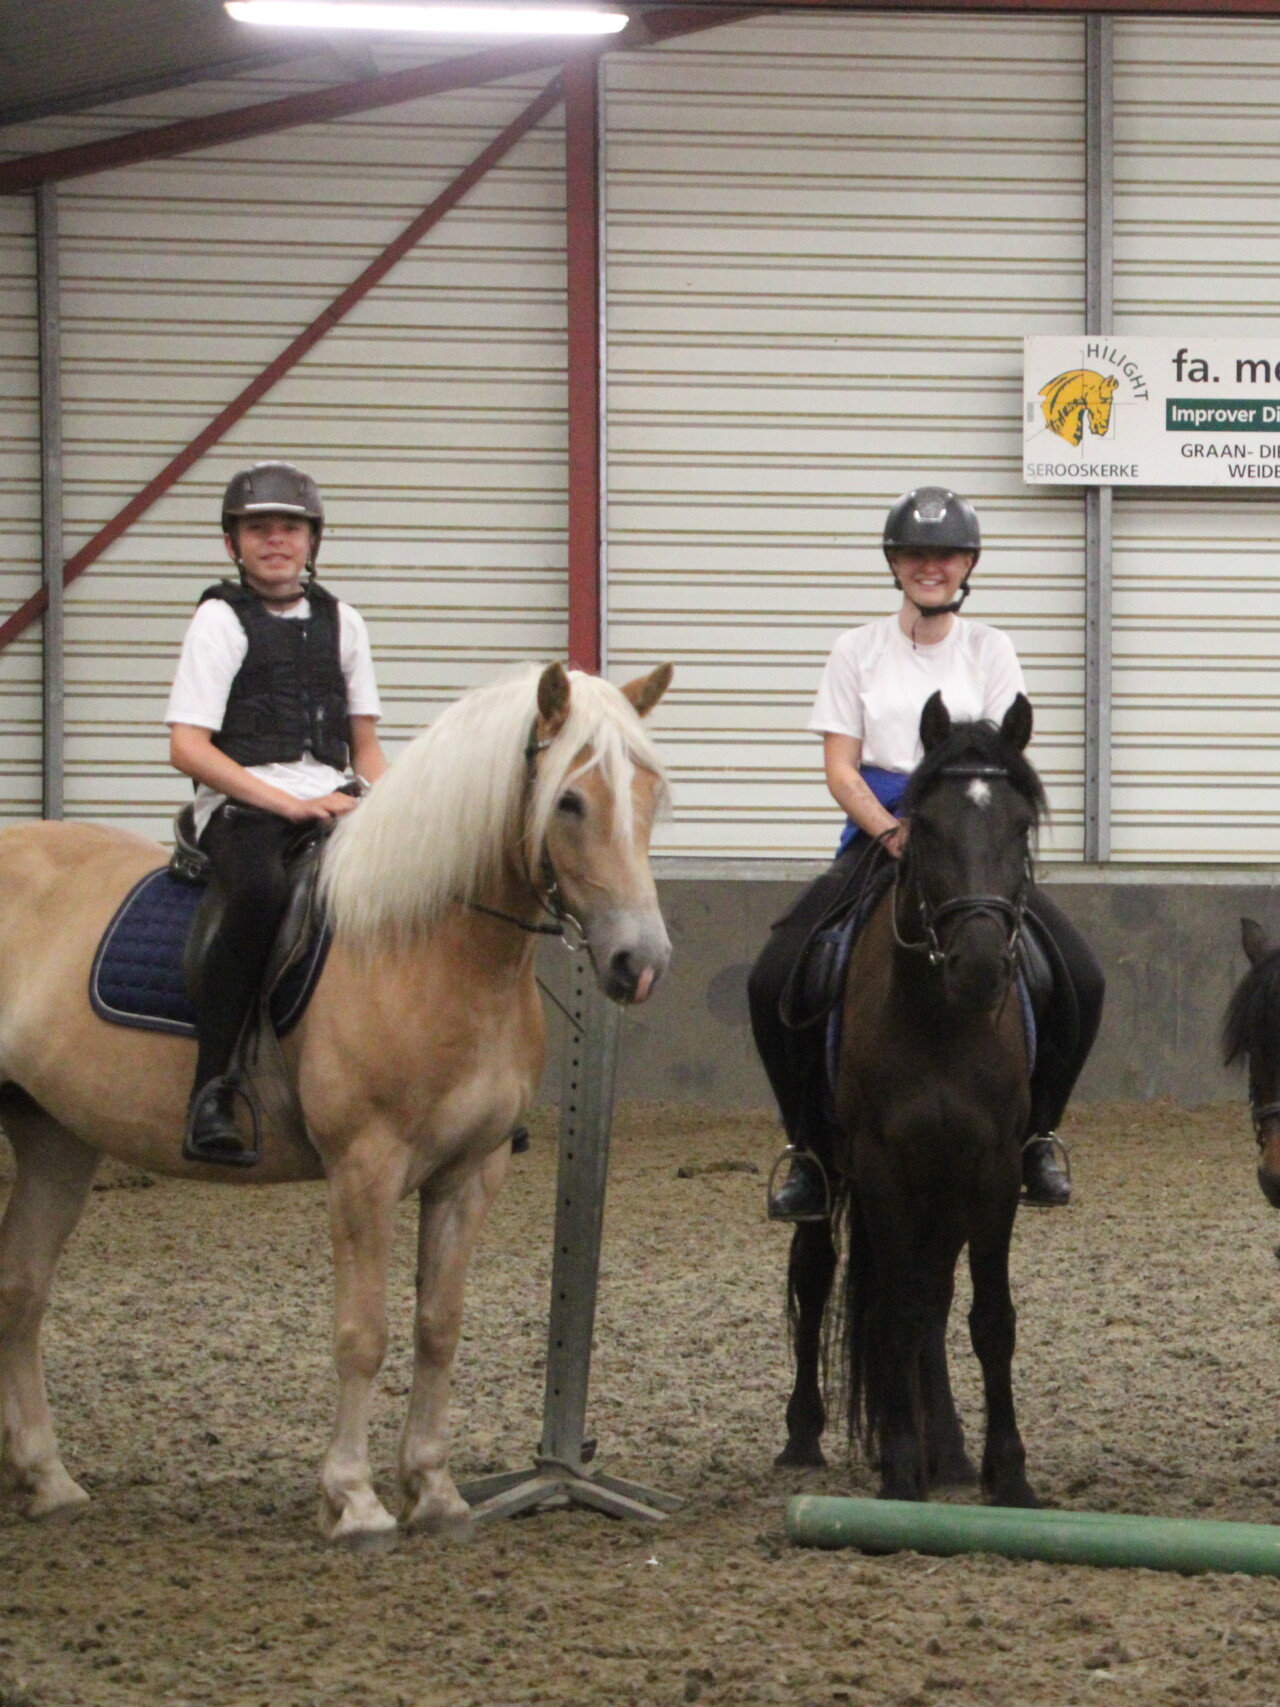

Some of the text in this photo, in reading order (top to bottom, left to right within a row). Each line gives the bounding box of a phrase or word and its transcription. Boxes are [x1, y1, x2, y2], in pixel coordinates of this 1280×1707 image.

[1087, 344, 1149, 401] HILIGHT
[1172, 348, 1220, 383] fa.
[1171, 405, 1256, 426] Improver
[1181, 443, 1253, 459] GRAAN-
[1027, 463, 1139, 478] SEROOSKERKE
